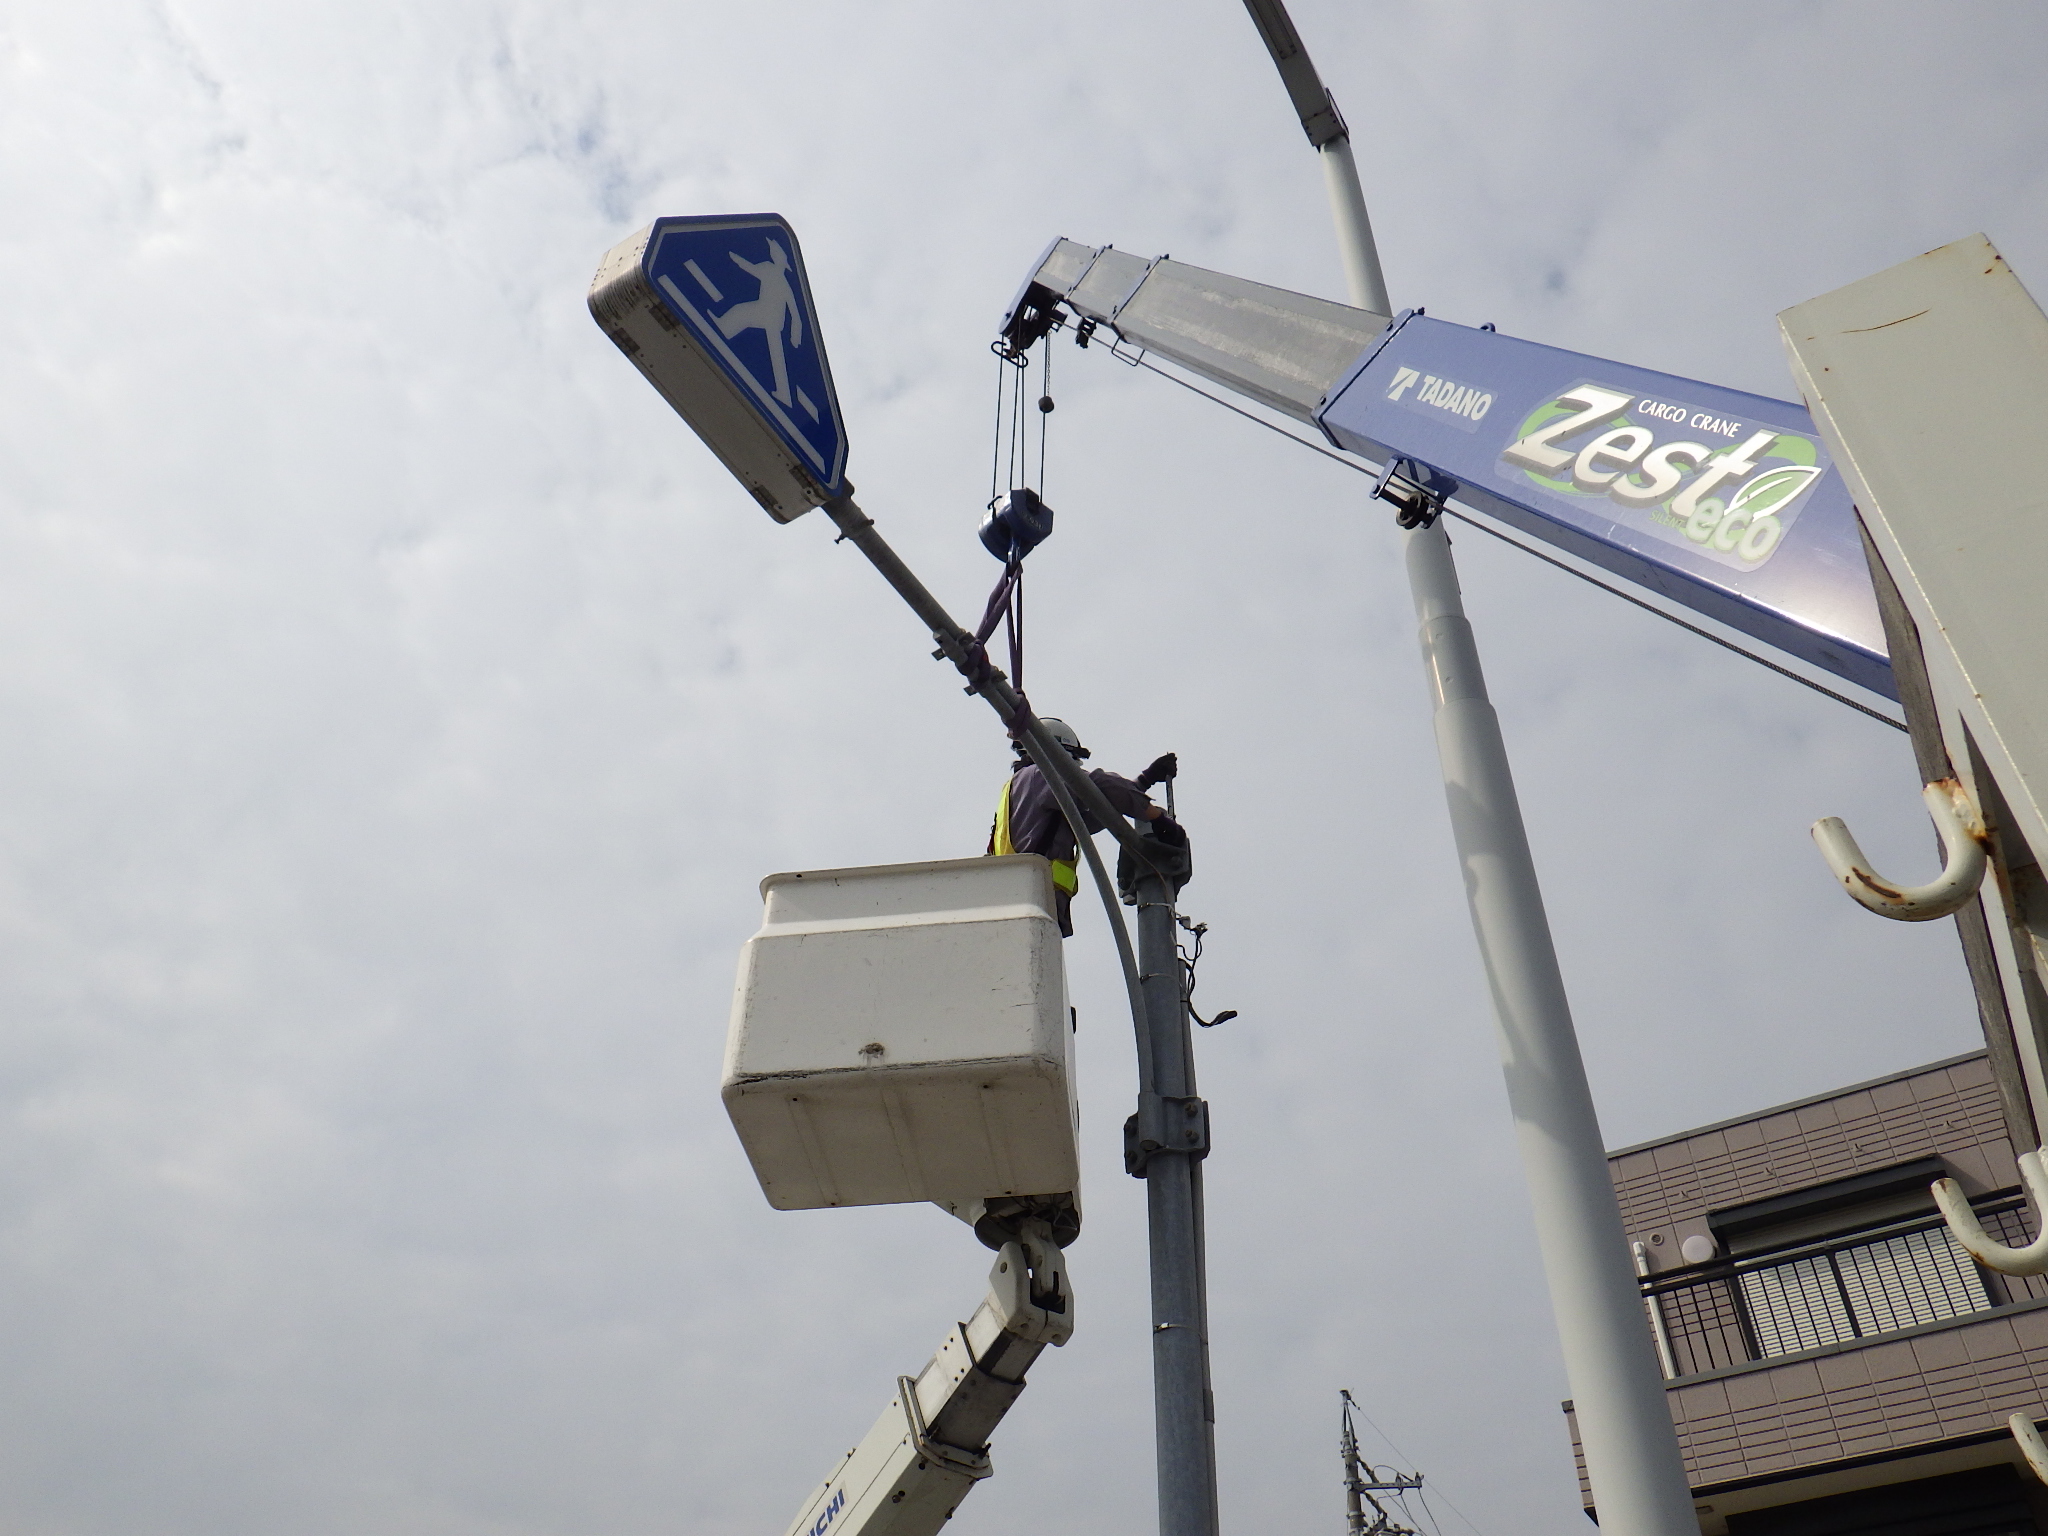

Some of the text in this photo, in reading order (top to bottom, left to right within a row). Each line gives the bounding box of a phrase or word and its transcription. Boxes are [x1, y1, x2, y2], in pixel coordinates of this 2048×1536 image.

[1417, 375, 1492, 420] TADANO
[1638, 400, 1741, 437] CARGO CRANE
[1502, 384, 1781, 520] Zest
[1649, 510, 1686, 529] SILENT
[1686, 497, 1781, 563] eco
